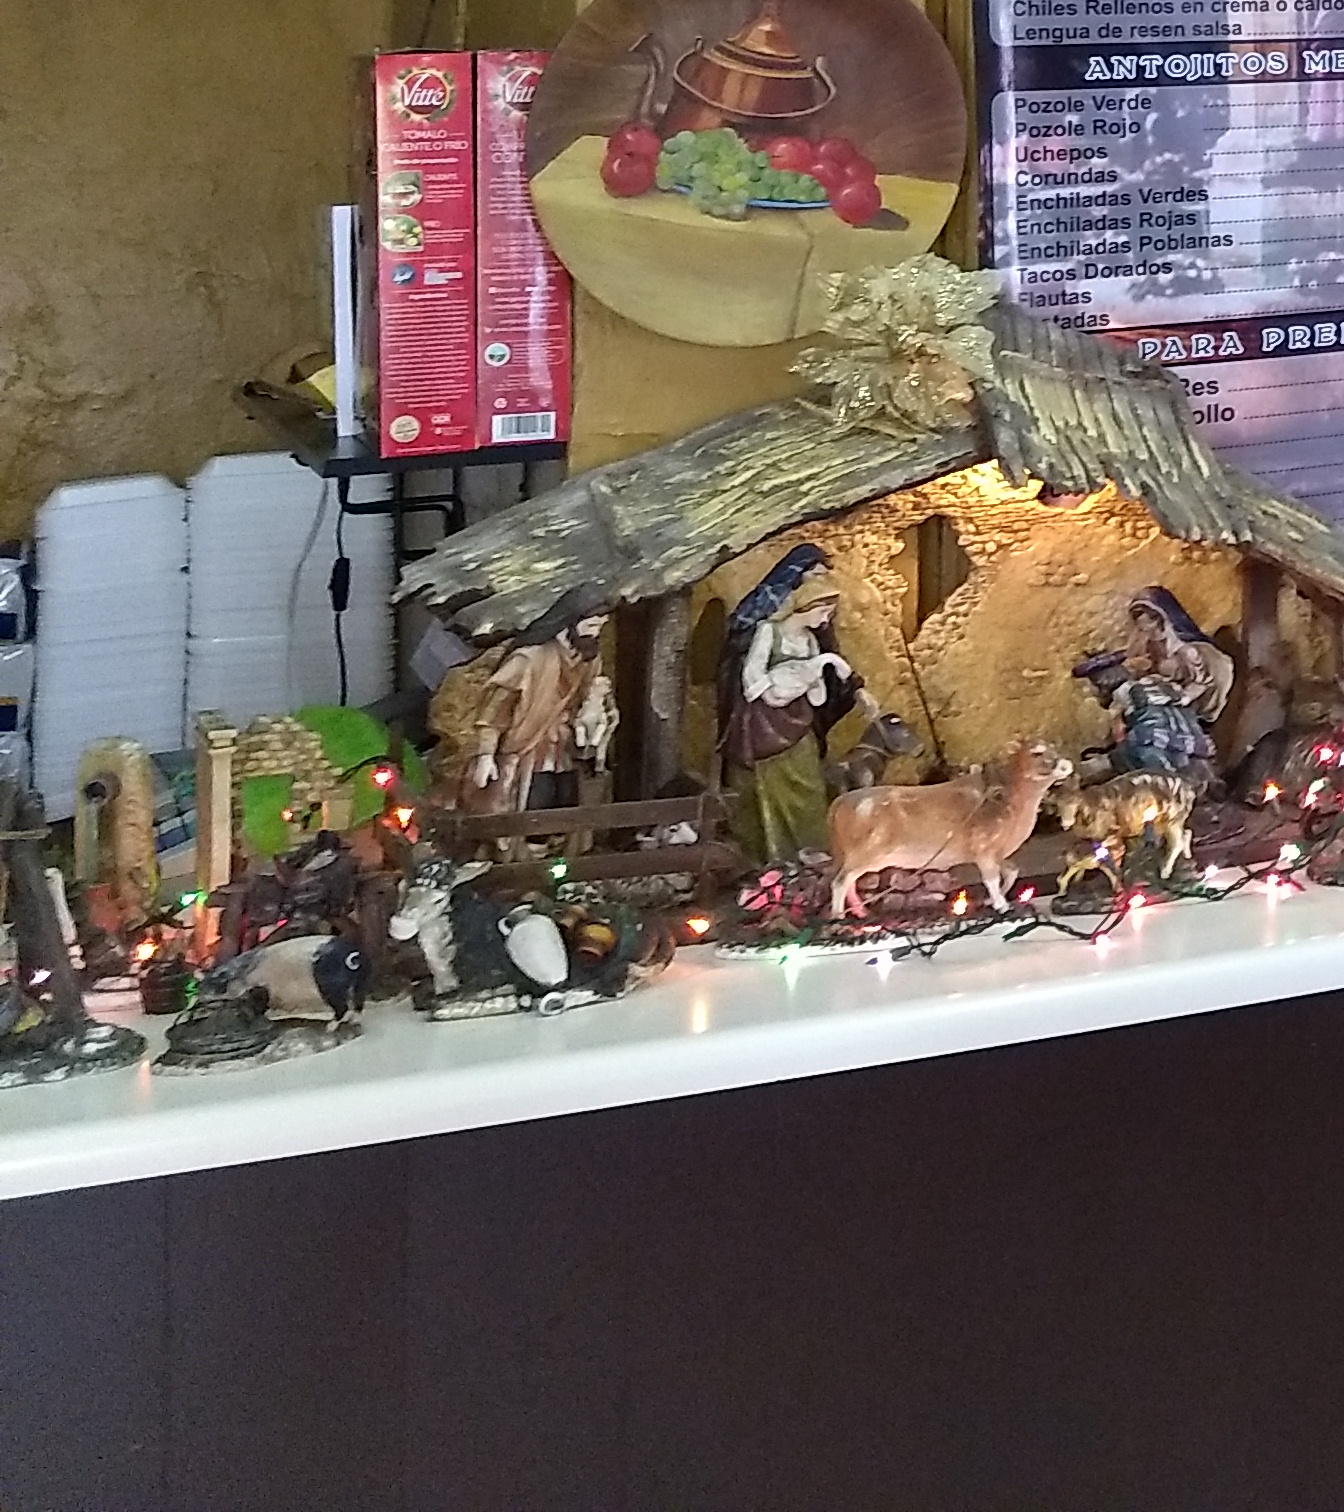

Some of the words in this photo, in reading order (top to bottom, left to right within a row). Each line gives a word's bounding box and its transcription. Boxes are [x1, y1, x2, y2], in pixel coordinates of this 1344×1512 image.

[1013, 0, 1078, 16] Chiles
[1085, 0, 1174, 15] Rellenos
[1181, 1, 1204, 14] en
[1211, 1, 1270, 13] crema
[1013, 24, 1090, 43] Lengua
[1098, 23, 1123, 38] de
[1192, 21, 1243, 36] salsa
[1084, 52, 1289, 81] ANTOJITOS
[504, 70, 537, 103] Vitt
[1015, 96, 1085, 114] Pozole
[1092, 94, 1152, 111] Verde
[1015, 120, 1085, 138] Pozole
[1093, 118, 1141, 138] Rojo
[1015, 145, 1109, 165] Uchepos
[1015, 167, 1118, 187] Corundas
[1016, 191, 1131, 212] Enchiladas
[1138, 186, 1209, 204] Verdes
[1017, 215, 1131, 236] Enchiladas
[1139, 211, 1197, 231] Rojas
[1018, 238, 1132, 260] Enchiladas
[1139, 233, 1234, 253] Poblanas
[1017, 267, 1077, 285] Tacos
[1084, 259, 1173, 281] Dorados
[1138, 331, 1245, 361] PARA
[1193, 403, 1235, 425] ollo
